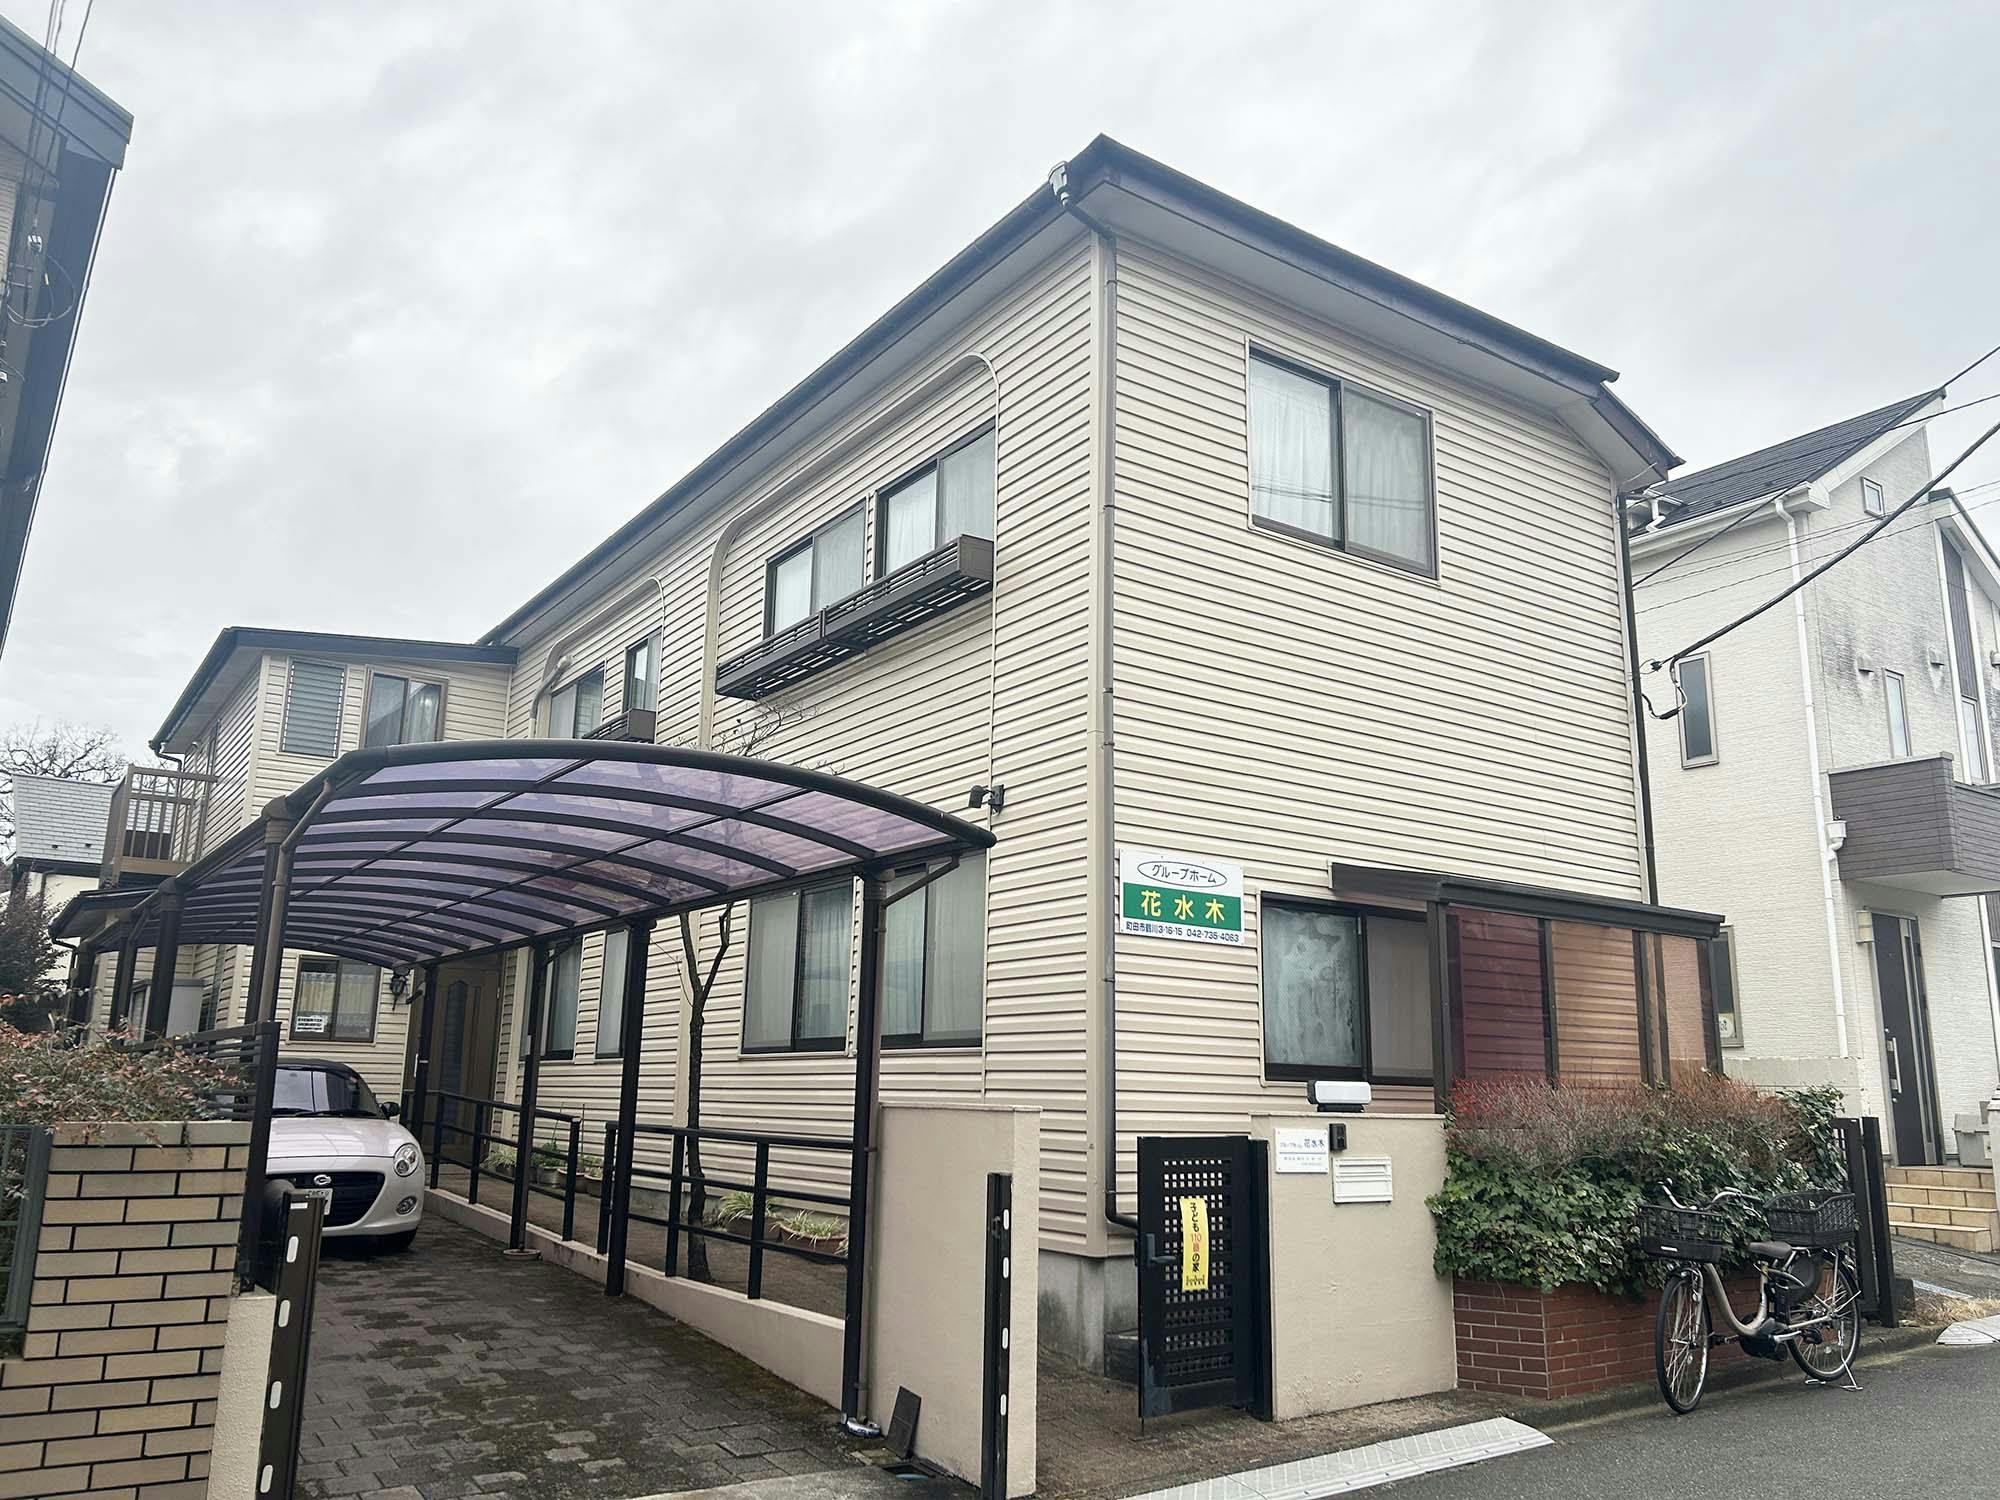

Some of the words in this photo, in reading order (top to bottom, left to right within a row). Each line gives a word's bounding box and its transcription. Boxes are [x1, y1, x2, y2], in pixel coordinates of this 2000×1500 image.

[1152, 864, 1216, 884] グループホーム
[1140, 890, 1225, 924] 花水木
